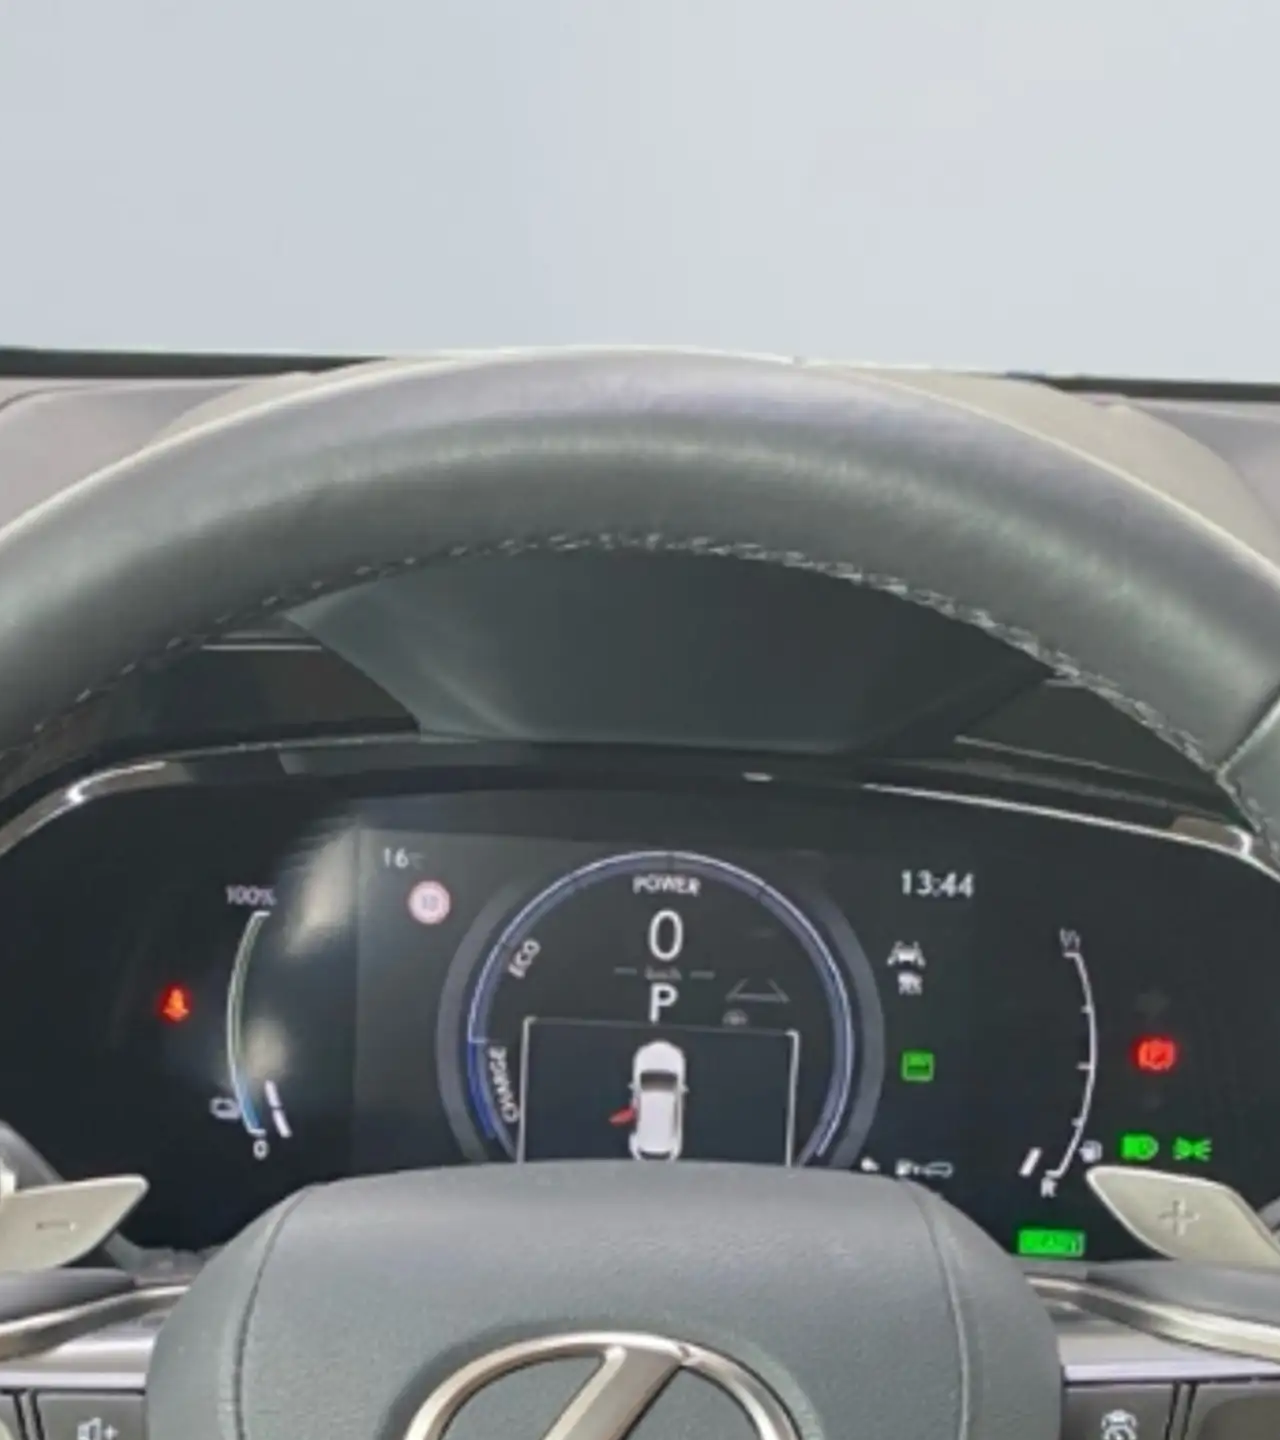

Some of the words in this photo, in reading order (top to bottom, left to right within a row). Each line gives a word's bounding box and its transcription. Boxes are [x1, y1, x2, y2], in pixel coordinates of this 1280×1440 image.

[225, 884, 277, 906] 100%
[632, 872, 702, 897] POWER
[899, 869, 975, 898] 13:44
[648, 908, 684, 962] 0
[507, 938, 542, 979] ECO
[649, 982, 679, 1025] P
